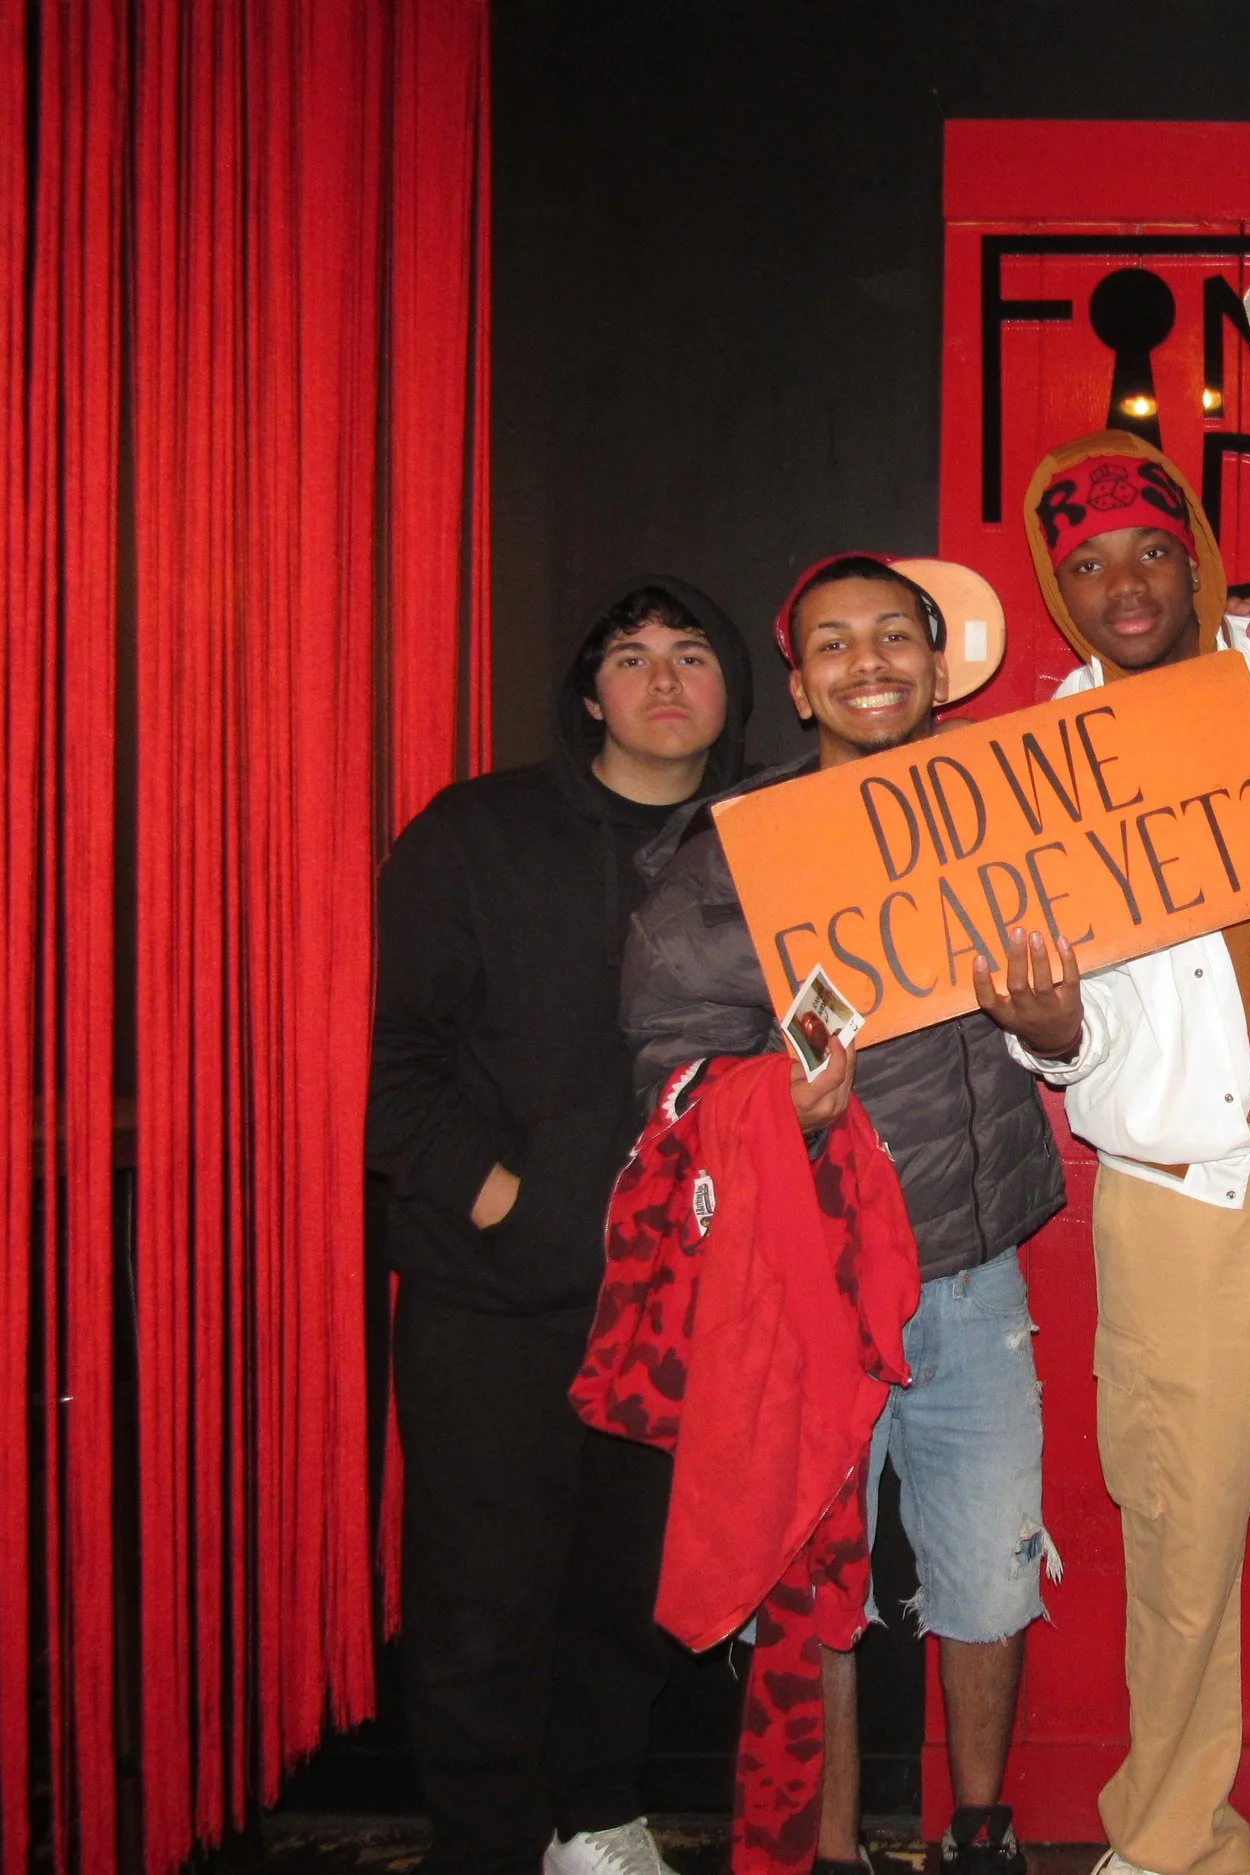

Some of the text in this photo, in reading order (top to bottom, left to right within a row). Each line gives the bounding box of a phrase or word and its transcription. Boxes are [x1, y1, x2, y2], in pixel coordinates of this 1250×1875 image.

[860, 706, 1143, 882] DID WE
[775, 841, 1094, 1015] ESCAPE
